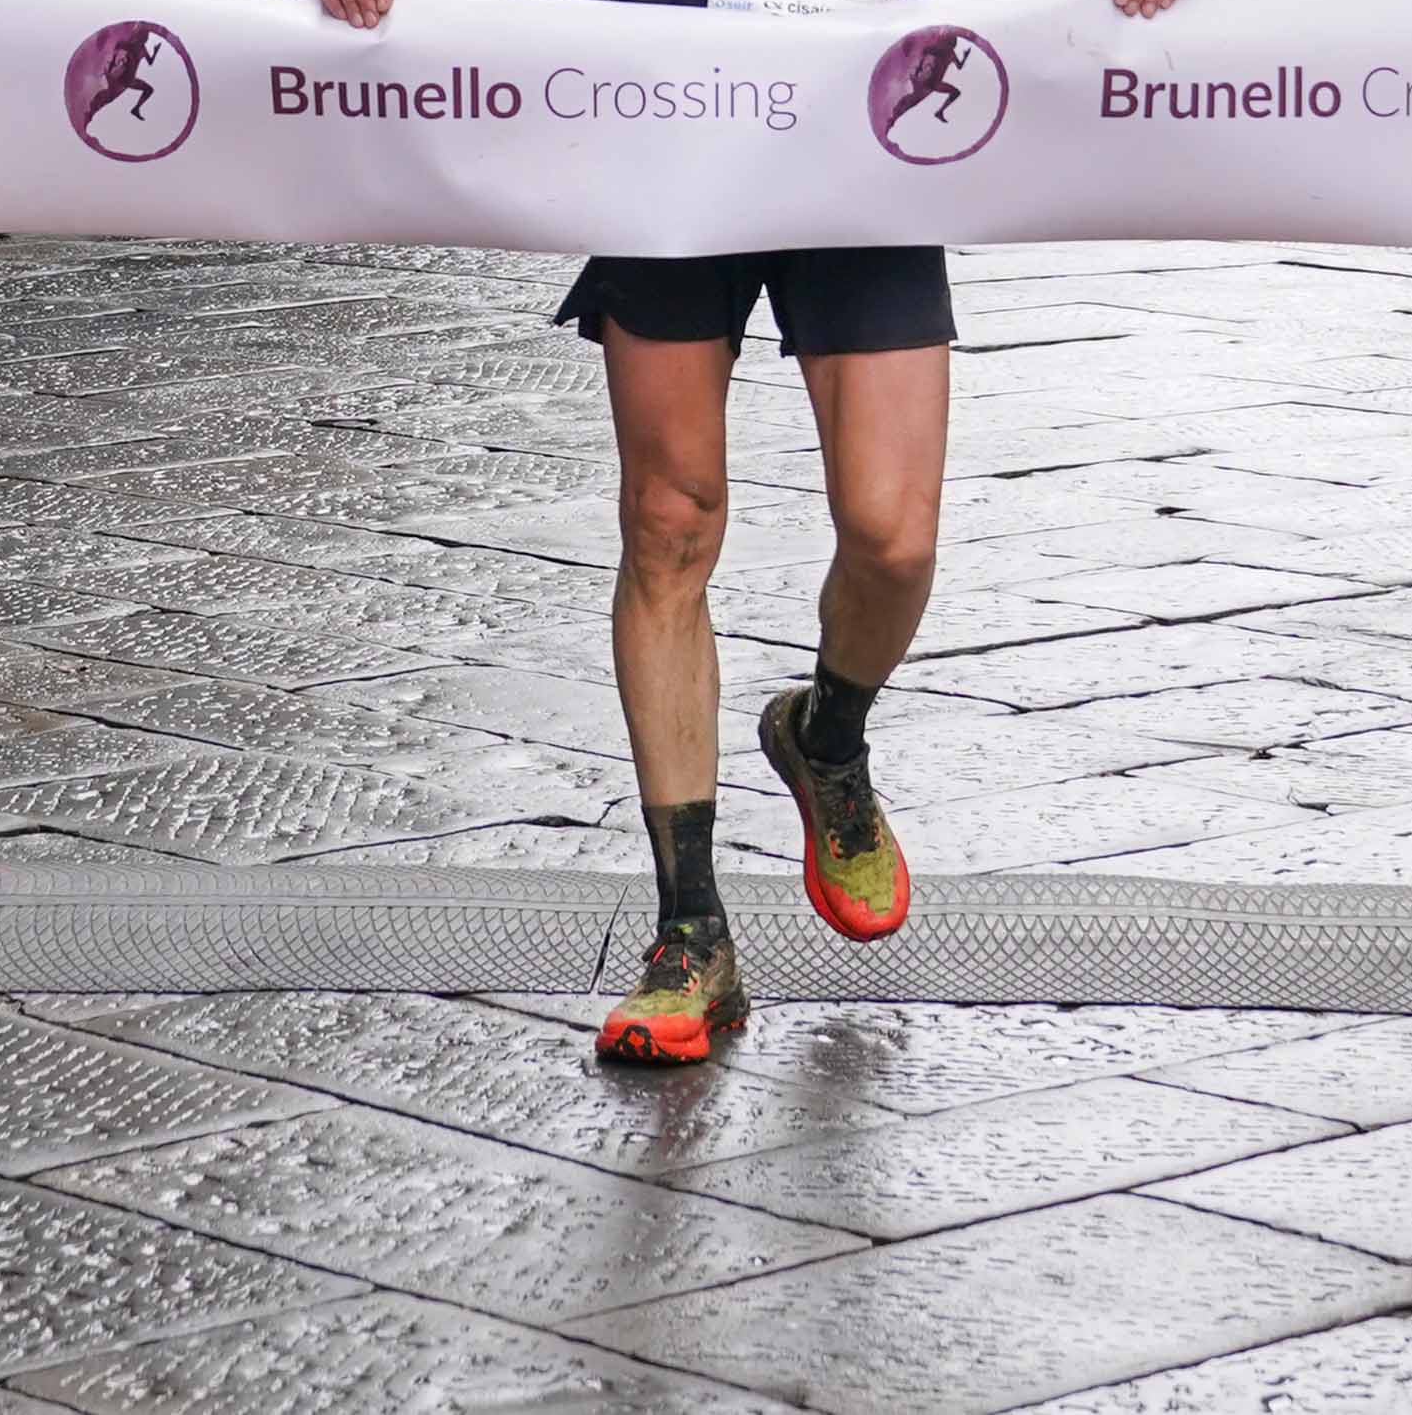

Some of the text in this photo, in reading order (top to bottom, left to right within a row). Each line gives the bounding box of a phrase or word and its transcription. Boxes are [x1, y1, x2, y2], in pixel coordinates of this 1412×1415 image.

[269, 65, 799, 131] Brunello Crossing
[1100, 66, 1342, 119] Brunello
